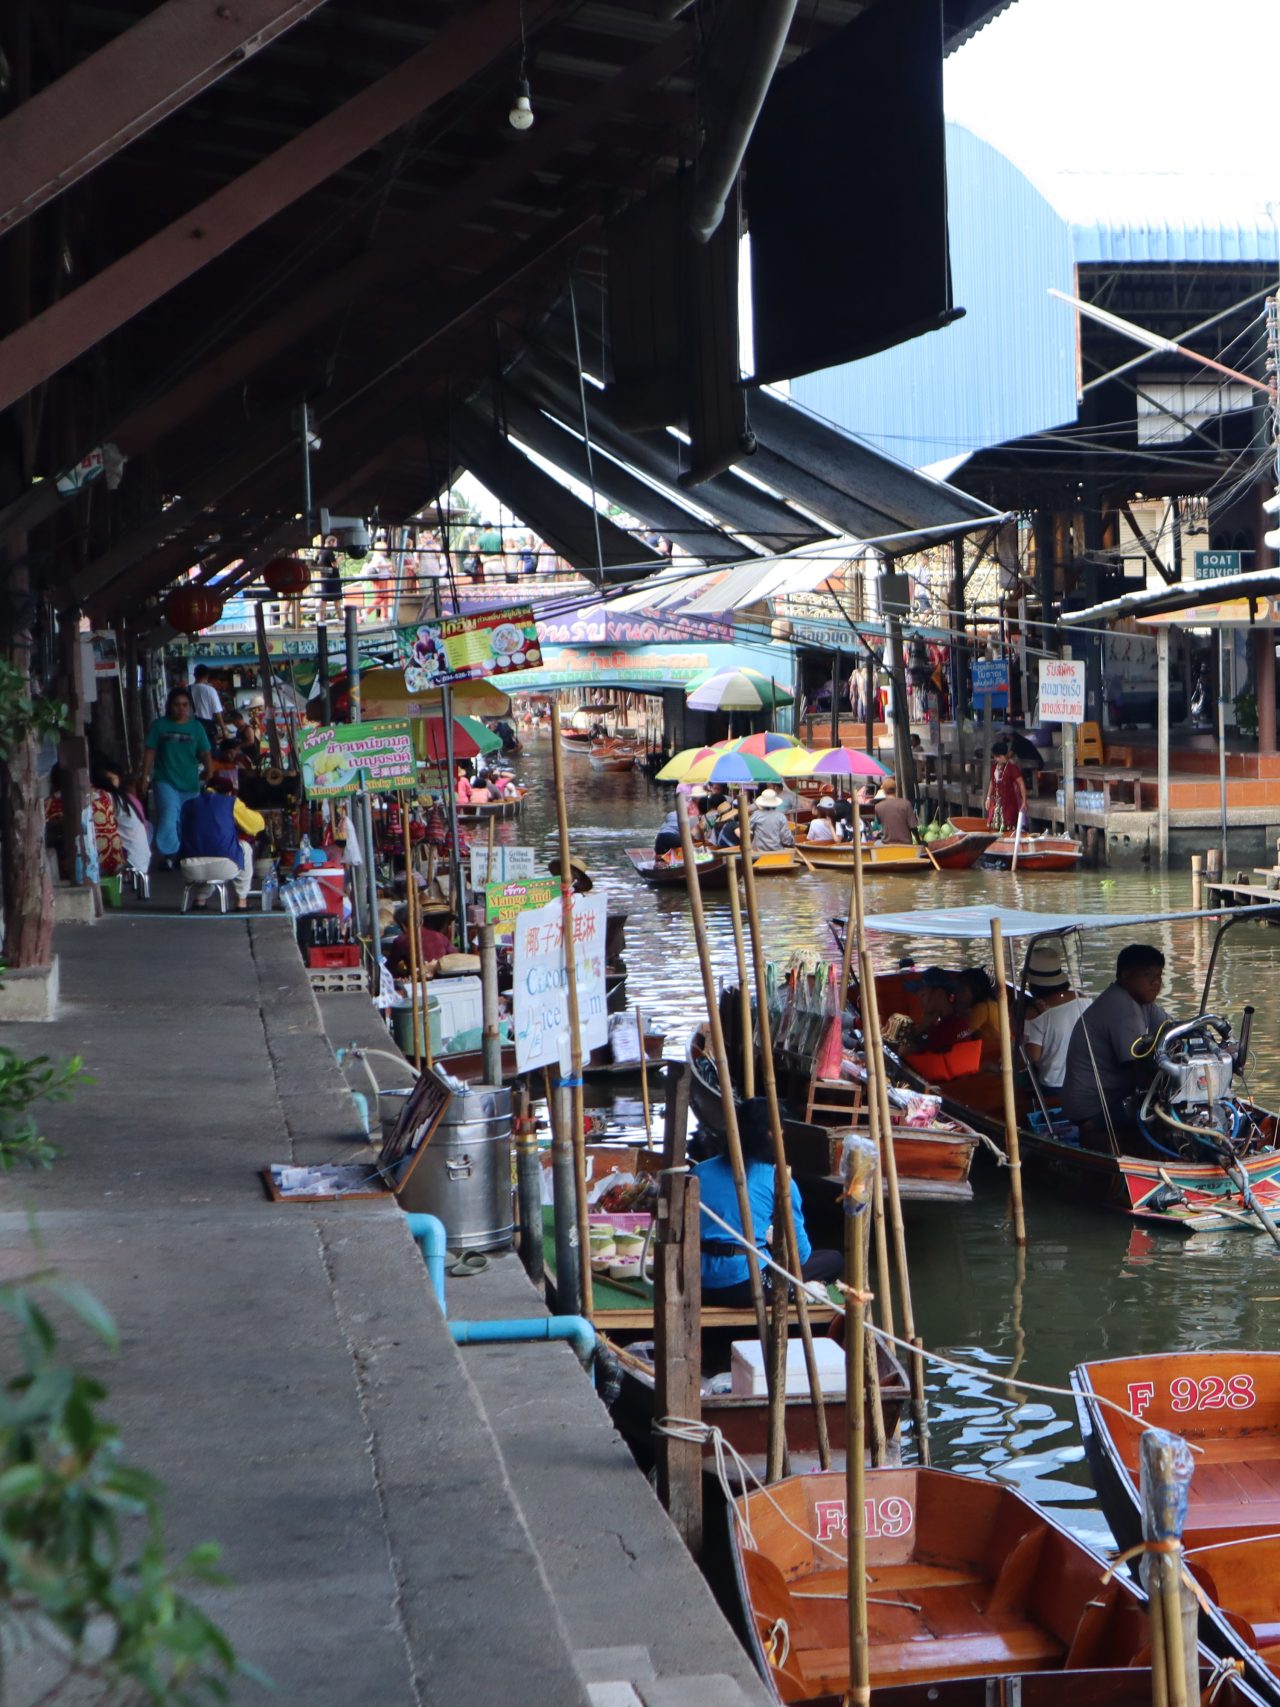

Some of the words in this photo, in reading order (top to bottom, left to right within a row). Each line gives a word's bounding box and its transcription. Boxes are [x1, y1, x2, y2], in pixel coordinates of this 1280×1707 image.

[1202, 555, 1232, 565] BOAT
[1196, 568, 1239, 578] SERVICE
[310, 786, 341, 796] Mango
[394, 776, 416, 786] Rice
[489, 895, 526, 906] Mango
[531, 890, 551, 902] and
[1127, 1382, 1154, 1418] F
[1169, 1374, 1256, 1412] 928
